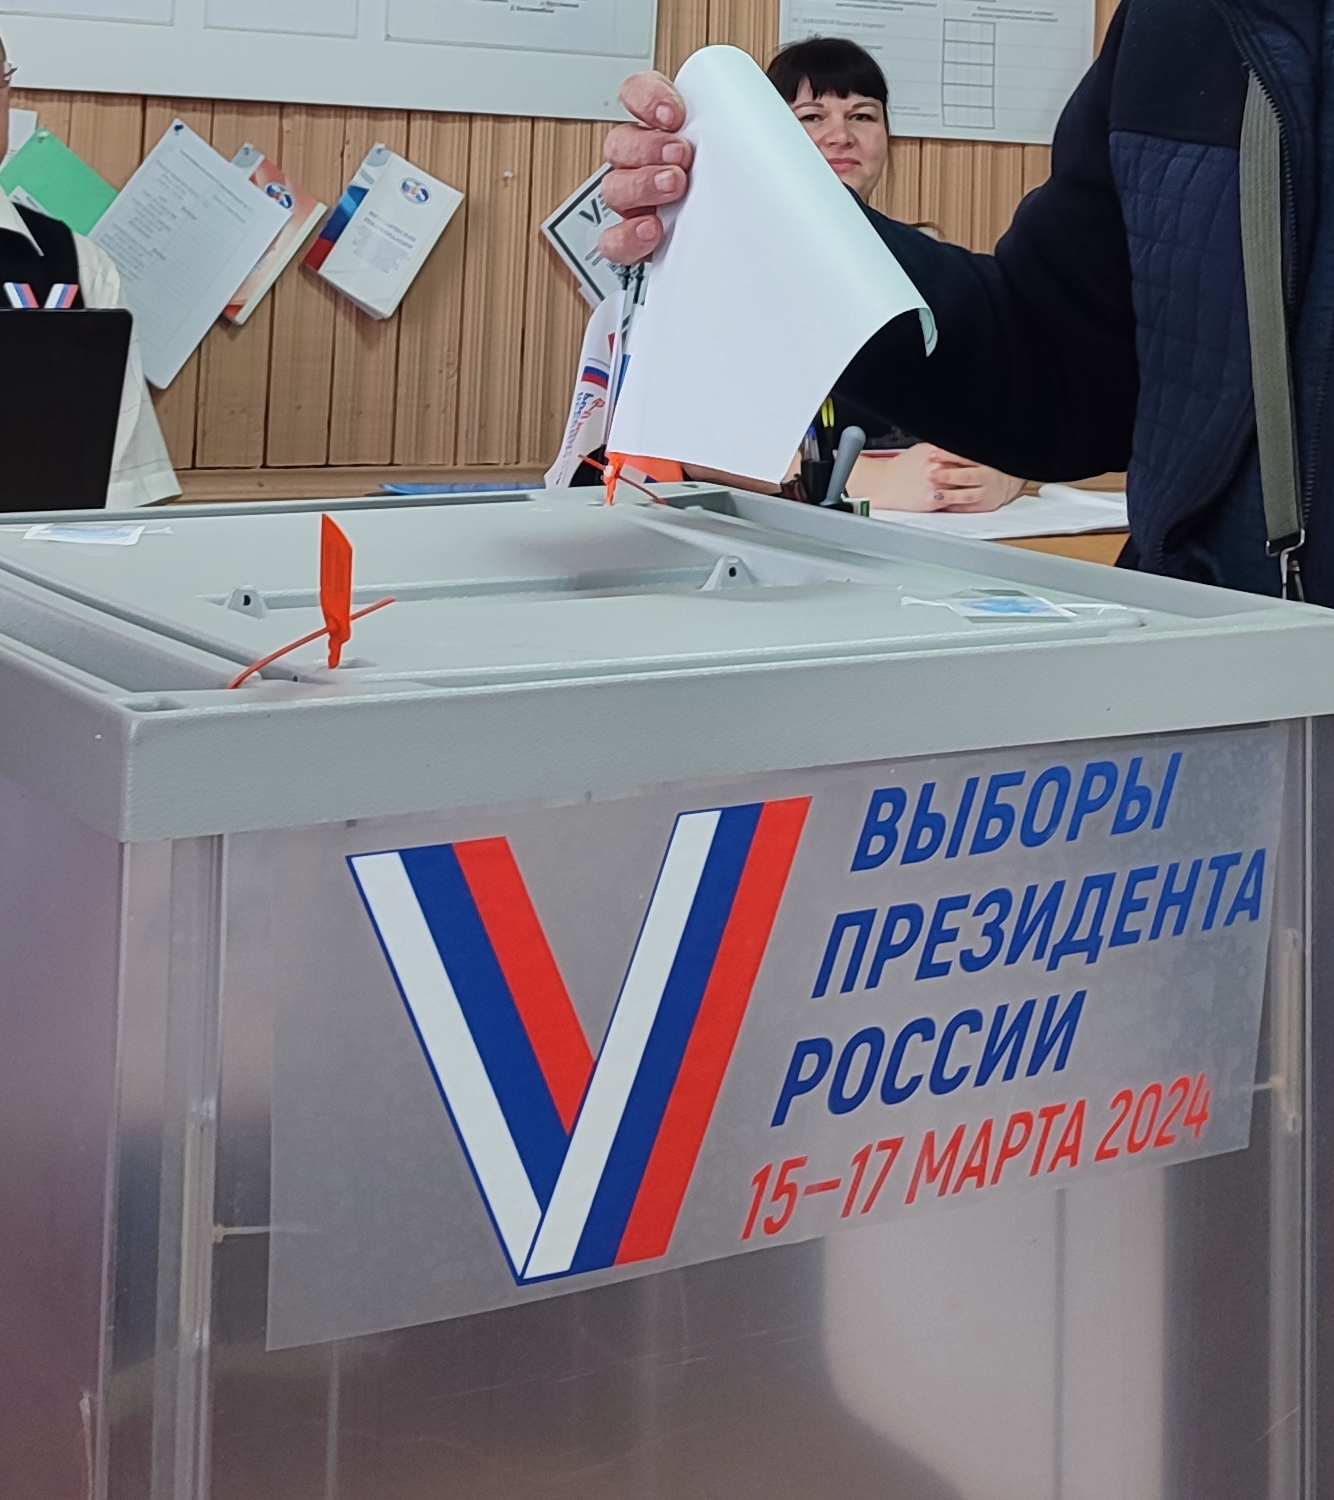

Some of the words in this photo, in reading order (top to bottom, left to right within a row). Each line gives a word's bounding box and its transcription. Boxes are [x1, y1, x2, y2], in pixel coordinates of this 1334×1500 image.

[850, 751, 1184, 873] ВЫБОРЫ
[811, 847, 1268, 1000] ПРЕЗИДЕНТА
[770, 989, 1089, 1129] РОССИИ
[904, 1098, 1088, 1206] МАРТА
[1094, 1072, 1212, 1164] 2024
